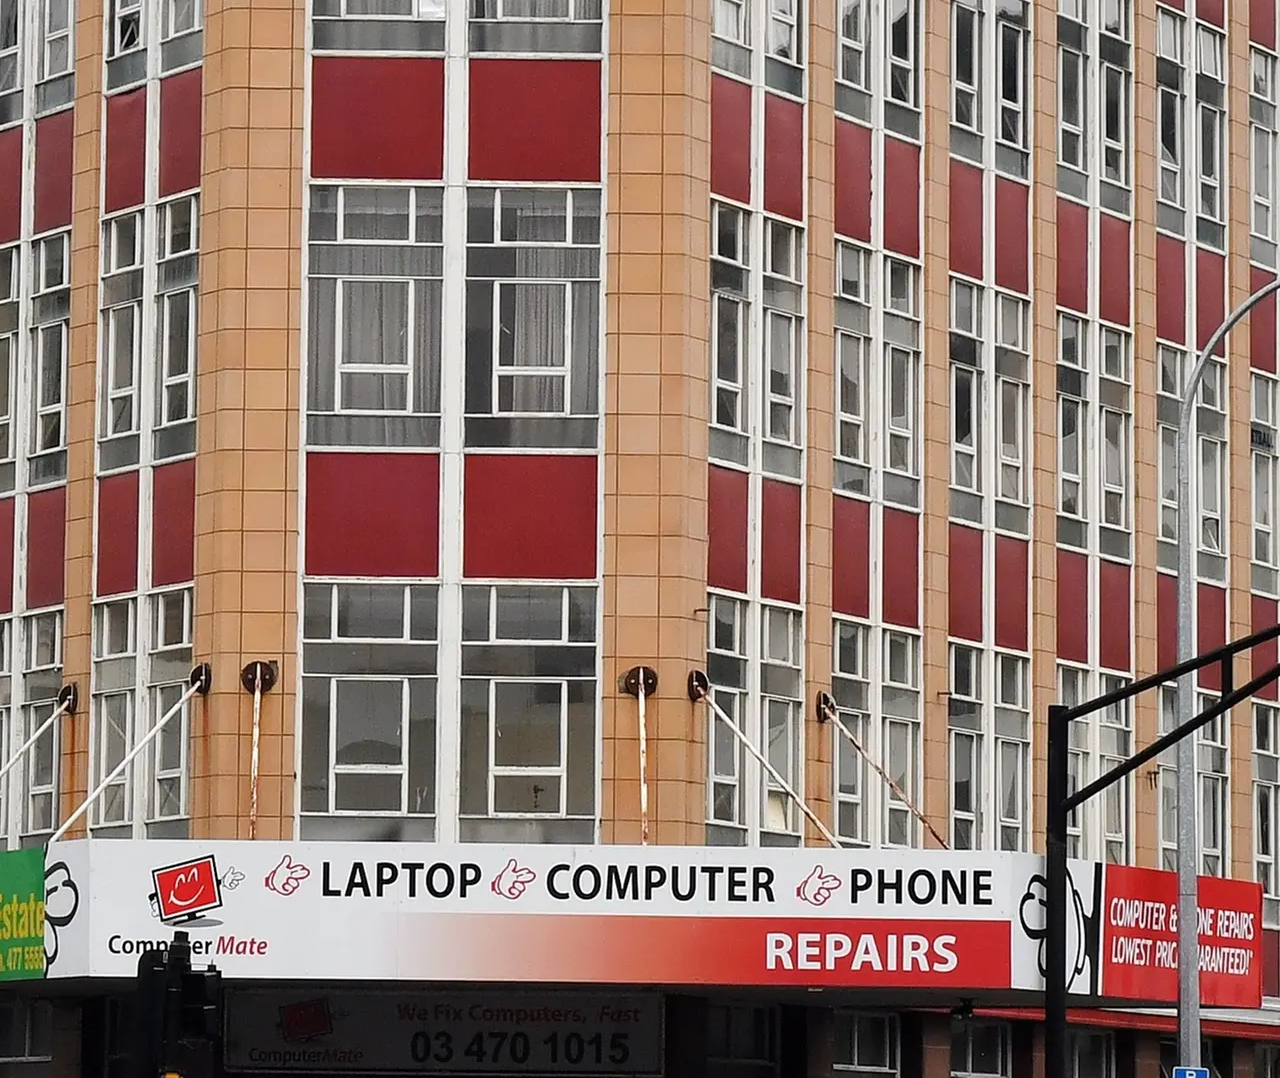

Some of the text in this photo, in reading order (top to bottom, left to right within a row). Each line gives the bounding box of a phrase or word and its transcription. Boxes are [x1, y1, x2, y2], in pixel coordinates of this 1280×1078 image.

[321, 861, 993, 905] LAPTOP COMPUTER PHONE
[1110, 897, 1167, 931] COMPUTER
[1169, 903, 1178, 933] &
[1217, 908, 1255, 941] REPAIRS
[765, 932, 959, 973] REPAIRS
[1111, 935, 1153, 966] LOWEST
[1154, 940, 1179, 970] PRIC
[397, 1003, 642, 1025] We Fix Computers, Fast
[410, 1031, 630, 1064] 03 470 1015
